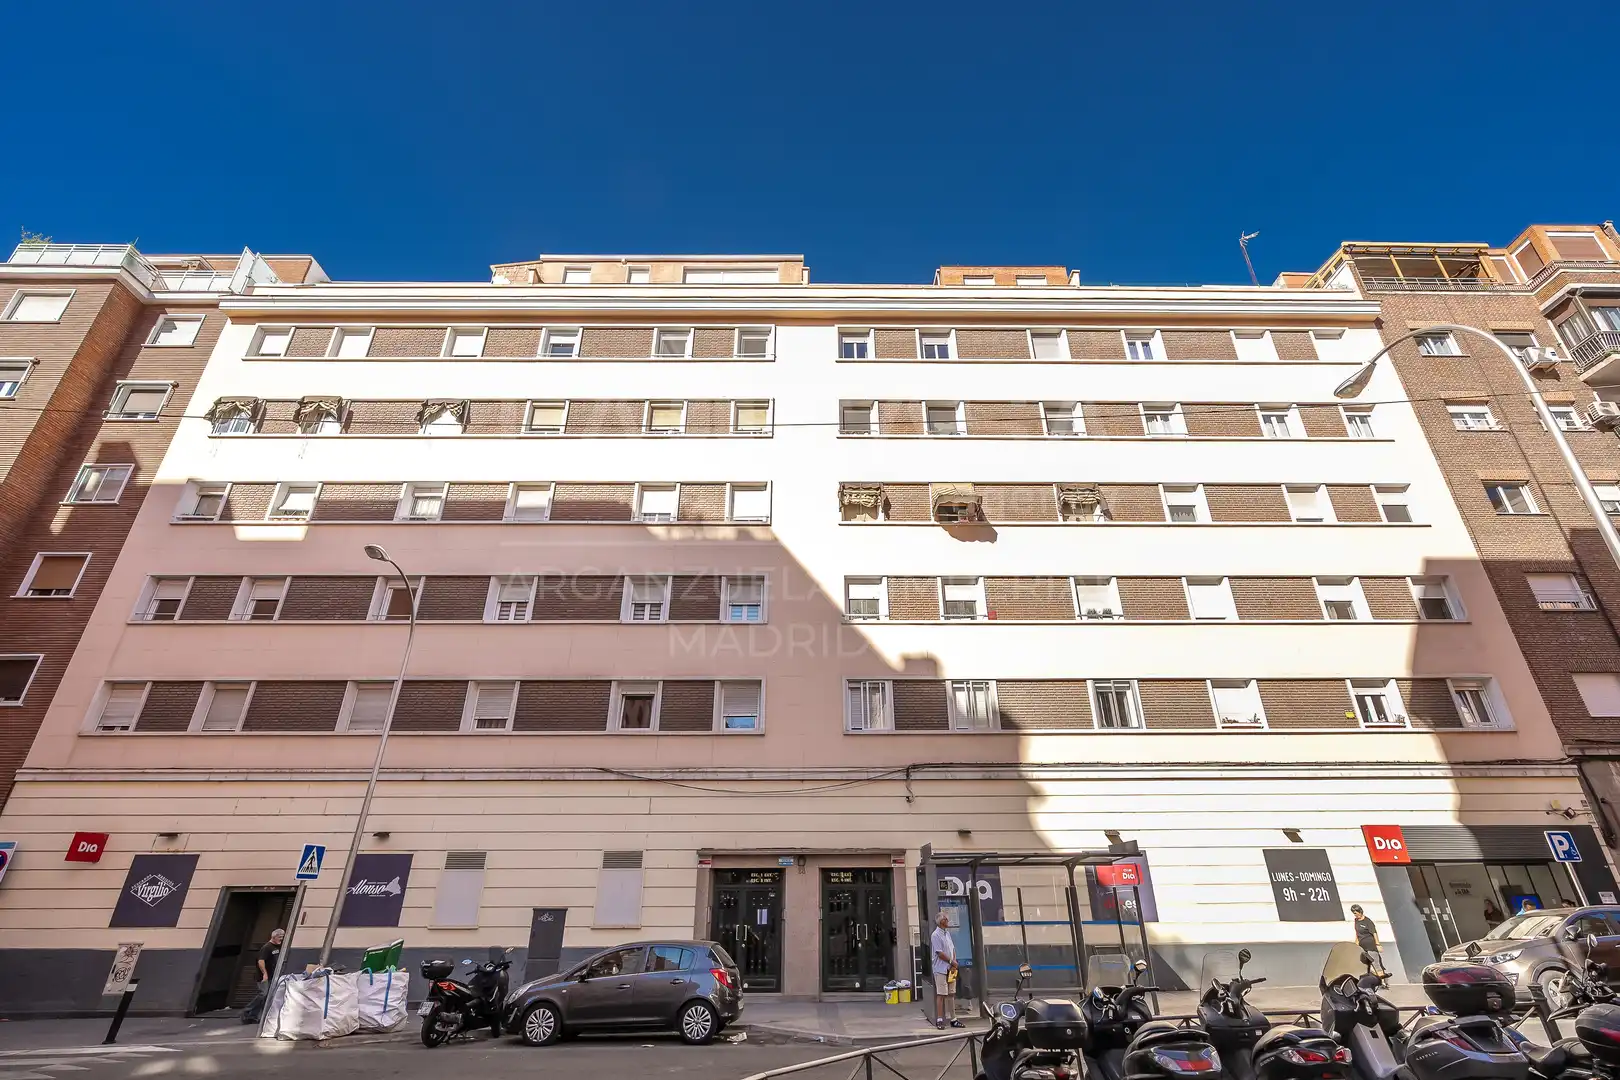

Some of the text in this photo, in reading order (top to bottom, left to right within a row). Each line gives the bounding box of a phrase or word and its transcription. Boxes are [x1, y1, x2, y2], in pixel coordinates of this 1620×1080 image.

[77, 841, 98, 853] Dia
[1373, 836, 1403, 850] Dia
[1551, 834, 1570, 858] P
[1122, 872, 1136, 880] Dia
[137, 881, 169, 902] Virgilio
[346, 878, 386, 895] Alonso
[944, 876, 993, 900] Dia
[1282, 887, 1298, 902] 9h
[1308, 887, 1331, 902] 22h
